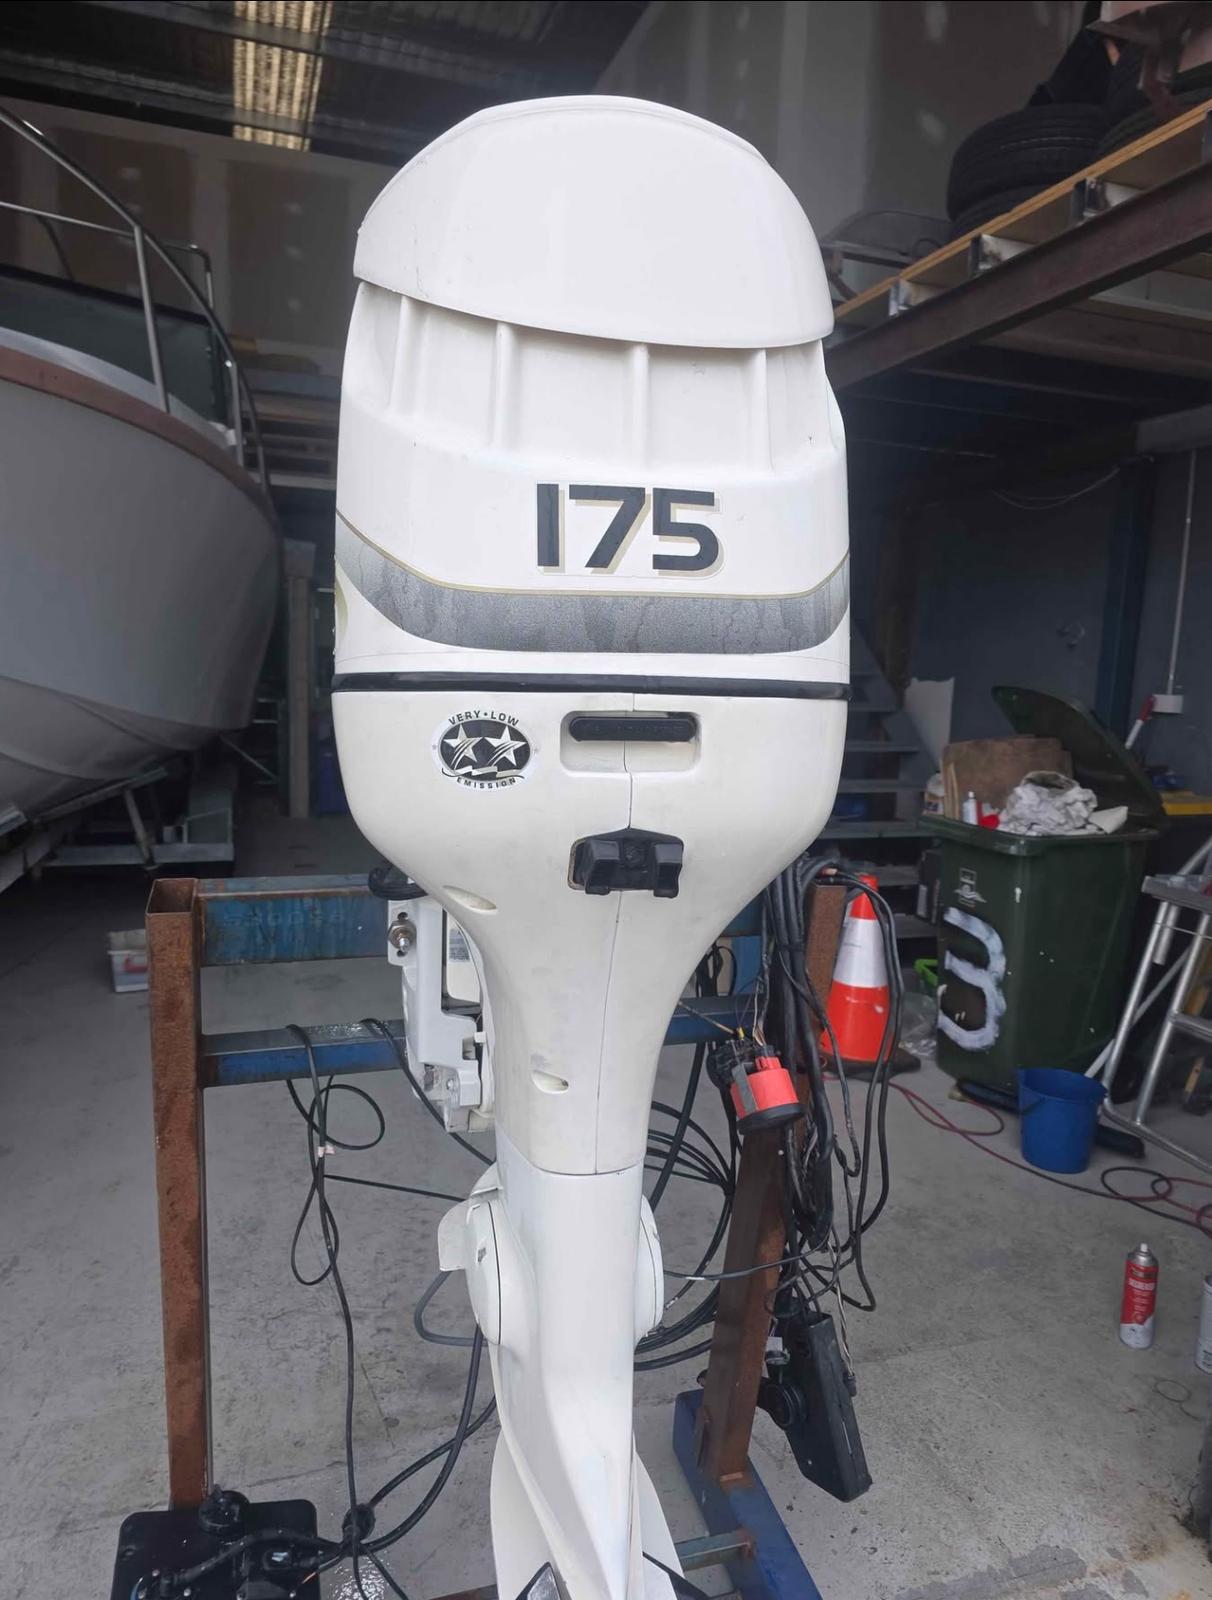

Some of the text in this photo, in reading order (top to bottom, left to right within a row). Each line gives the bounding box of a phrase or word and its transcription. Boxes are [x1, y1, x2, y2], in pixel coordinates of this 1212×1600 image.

[537, 483, 724, 576] 175
[448, 710, 519, 726] VERY LOW
[457, 777, 516, 789] EMISSION
